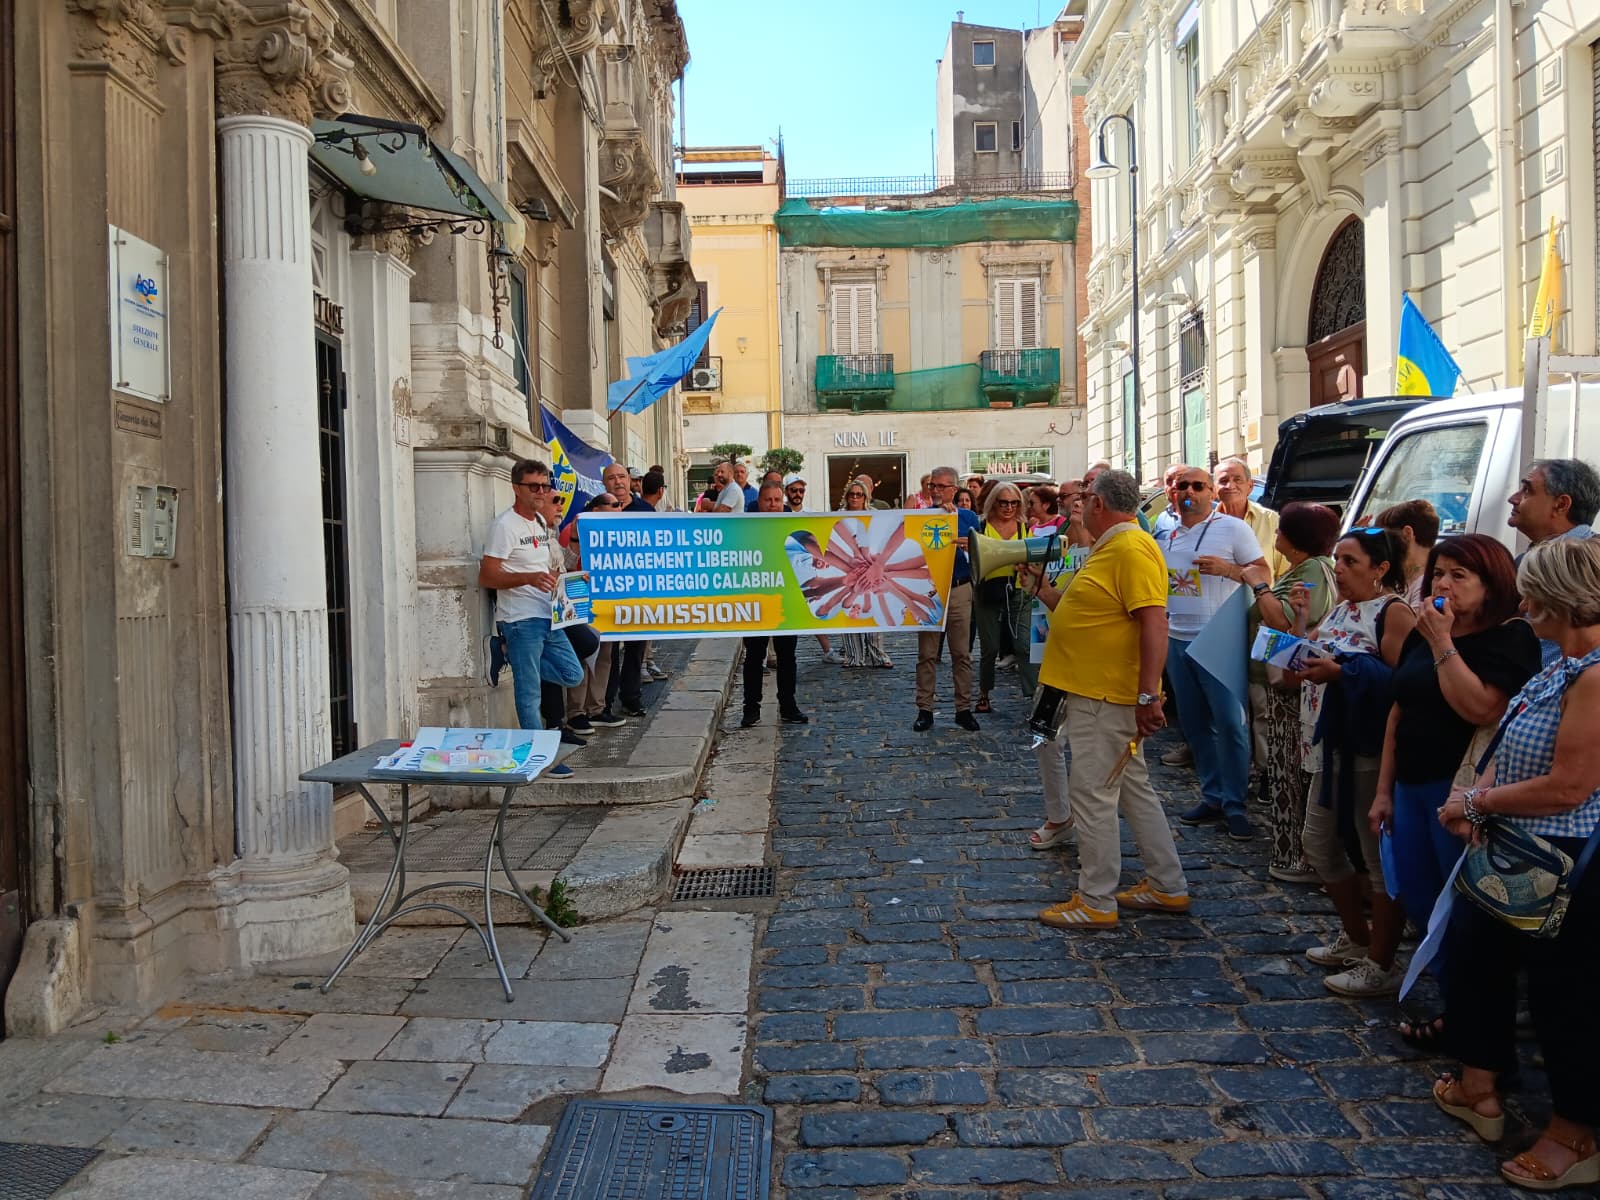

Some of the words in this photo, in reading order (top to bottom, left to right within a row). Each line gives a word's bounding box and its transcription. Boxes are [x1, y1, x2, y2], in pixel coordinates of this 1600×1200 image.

[136, 273, 155, 297] ASP
[133, 337, 160, 352] GENERALE
[834, 431, 868, 447] NUNA
[879, 431, 898, 447] LIE
[987, 461, 1013, 474] NUNA
[1015, 461, 1031, 474] LIE
[589, 531, 604, 547] DI
[607, 530, 652, 547] FURIA
[655, 530, 674, 546] ED
[677, 530, 690, 545] IL
[694, 529, 723, 545] SUO
[590, 551, 694, 570] MANAGEMENT
[697, 550, 763, 568] LIBERINO
[591, 575, 635, 592] L'ASP
[638, 575, 653, 591] DI
[656, 573, 710, 591] REGGIO
[713, 571, 786, 589] CALABRIA
[614, 601, 762, 625] DIMISSIONI
